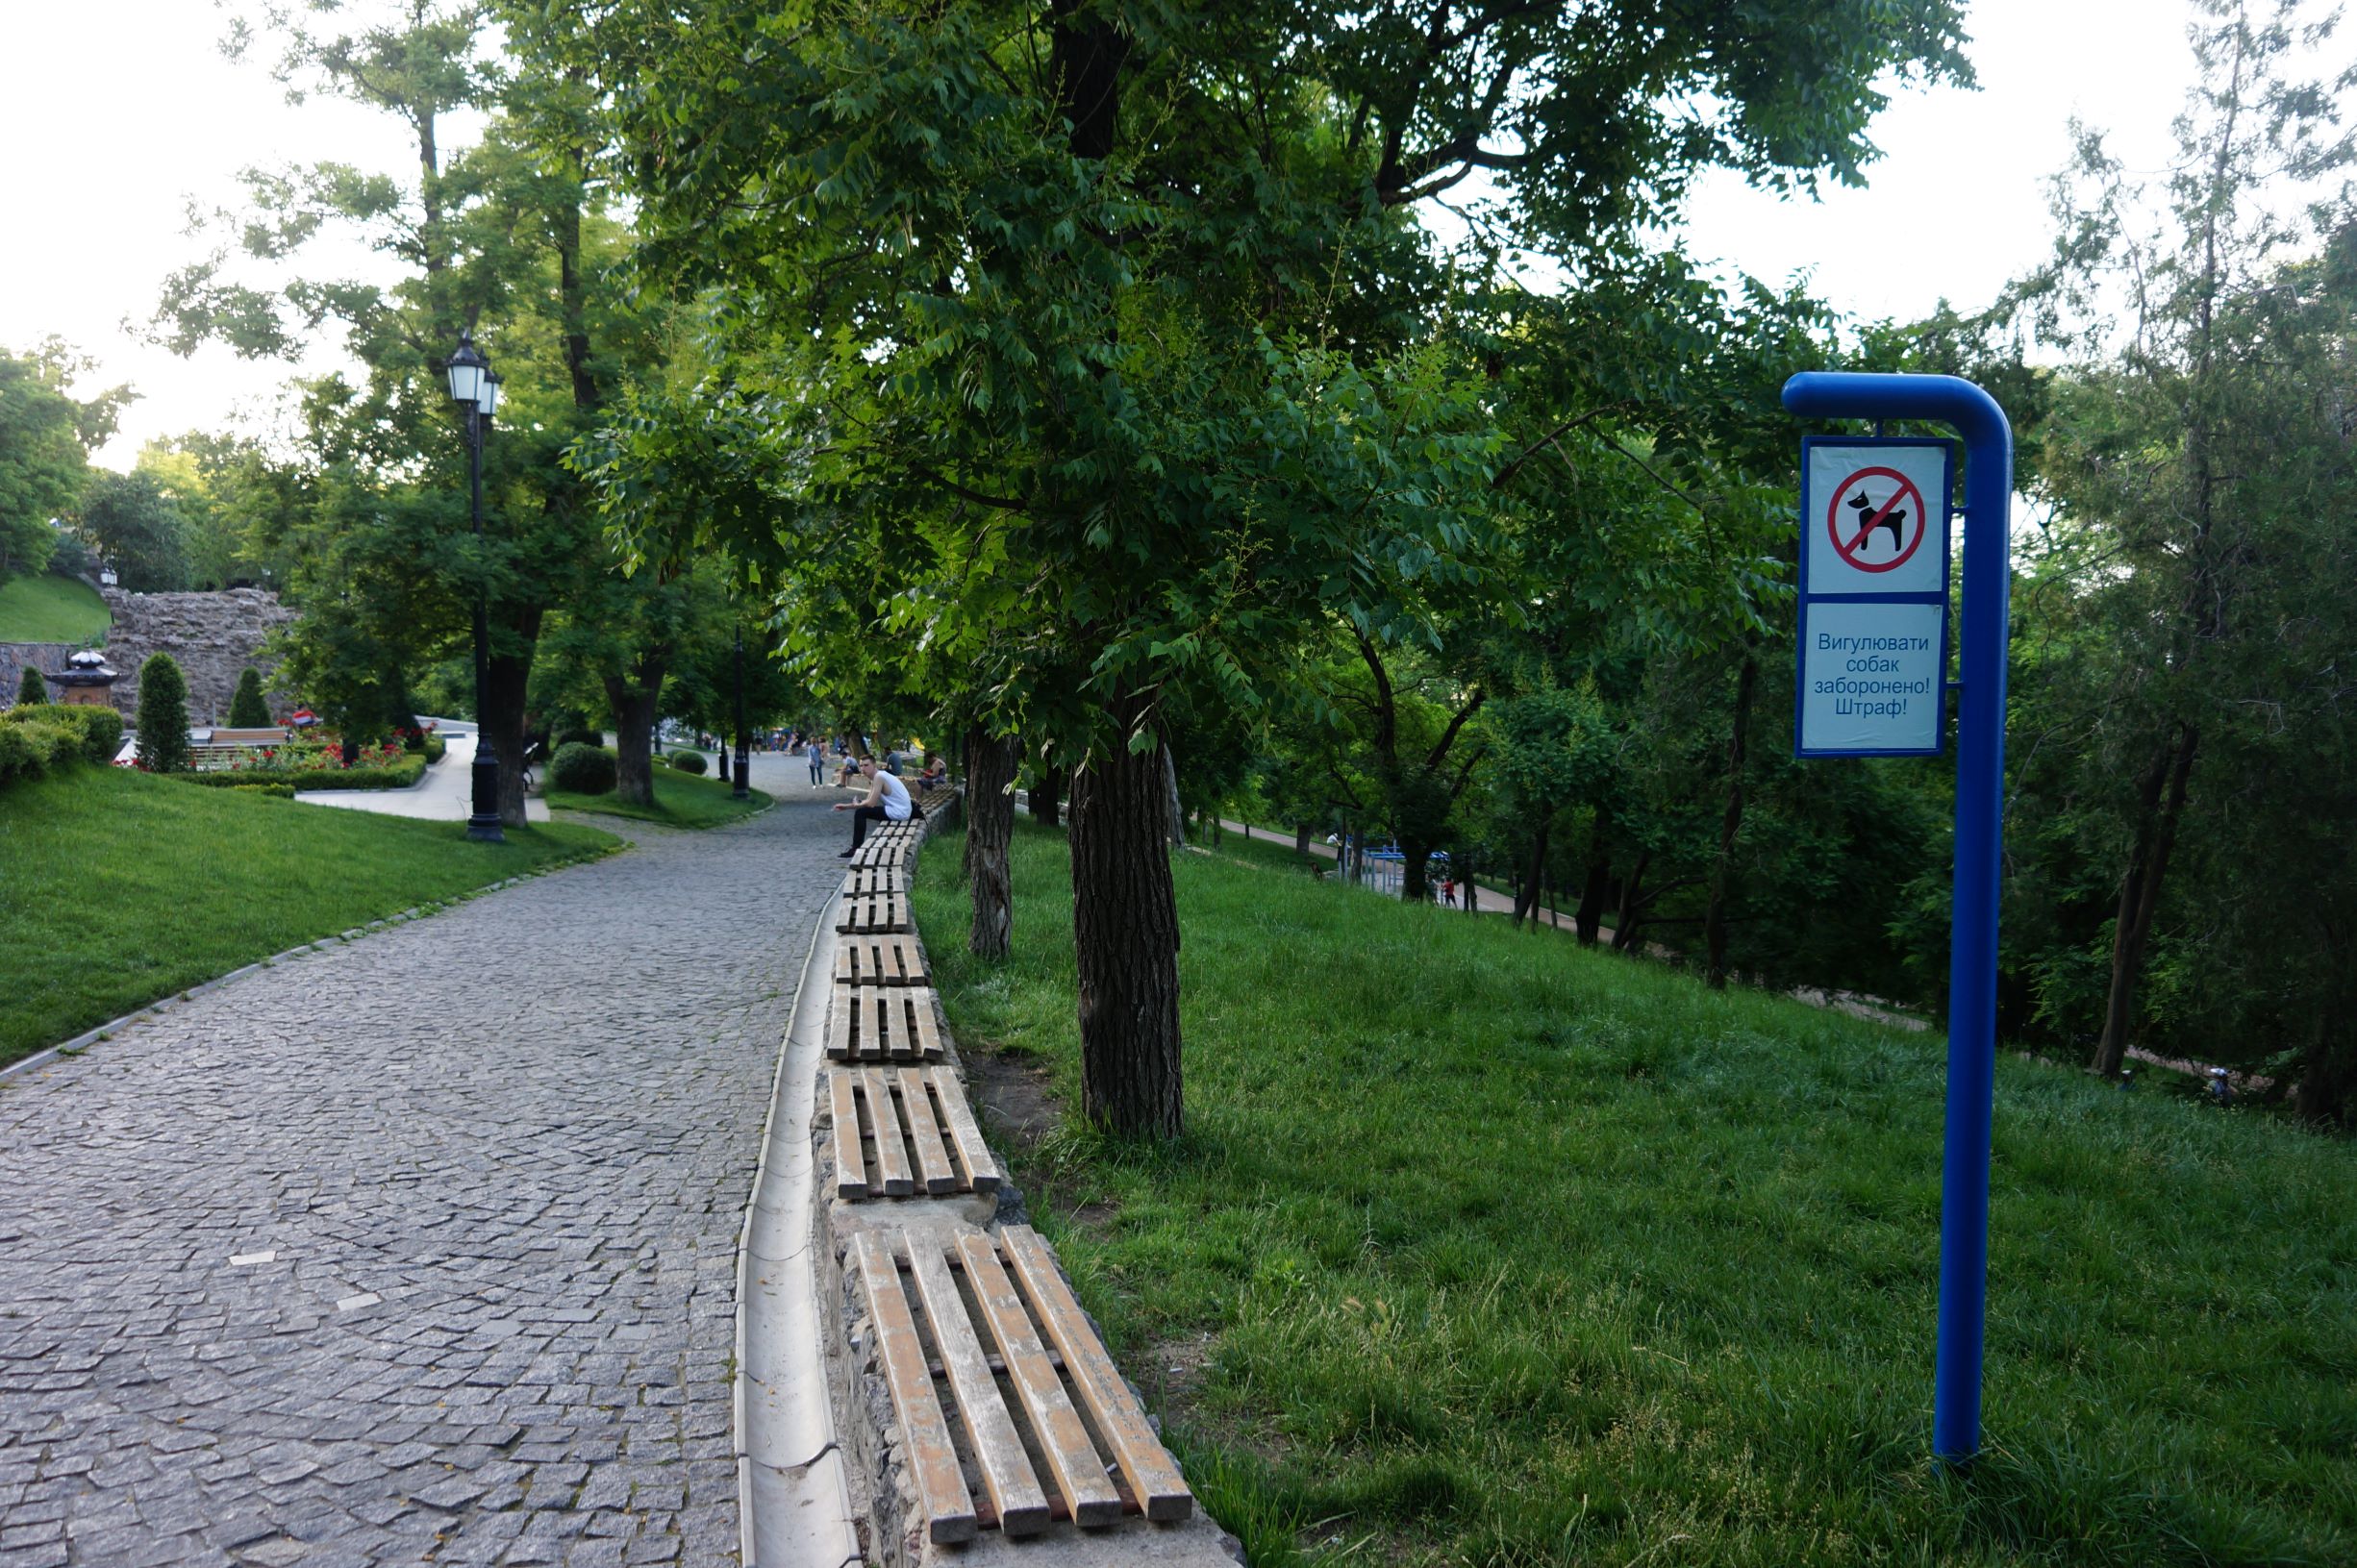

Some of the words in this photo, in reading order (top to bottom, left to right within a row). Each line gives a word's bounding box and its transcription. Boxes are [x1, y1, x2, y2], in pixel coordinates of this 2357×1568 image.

[1818, 633, 1929, 655] Вигулювати
[1845, 655, 1900, 673] собак
[1814, 676, 1930, 698] заборонено!
[1835, 698, 1908, 719] Штраф!
